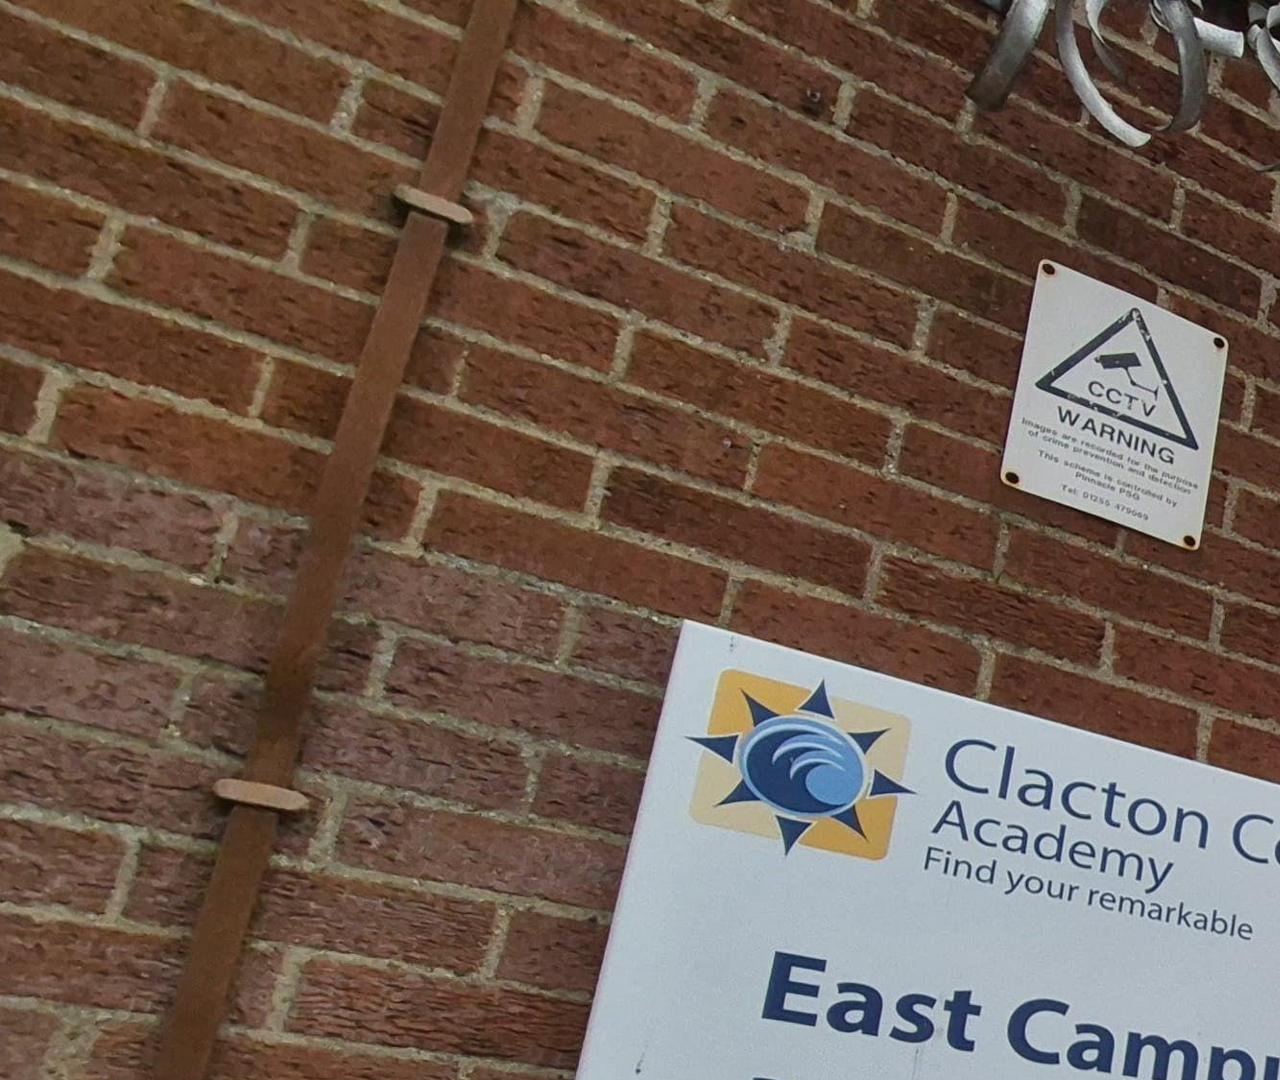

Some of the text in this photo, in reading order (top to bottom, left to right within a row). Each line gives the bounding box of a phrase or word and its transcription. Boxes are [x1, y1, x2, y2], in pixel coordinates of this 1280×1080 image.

[1088, 381, 1157, 417] CCTV
[1022, 417, 1058, 436] Images
[1062, 434, 1077, 443] are
[1081, 440, 1124, 460] recorded
[1144, 463, 1158, 473] the
[1162, 472, 1198, 490] purpose
[1028, 430, 1191, 494] of crime prevention and detection
[1057, 406, 1175, 465] WARNING
[1039, 449, 1177, 507] This scheme is controlled by
[1076, 471, 1115, 491] Pinnacle
[945, 739, 1209, 849] Clacton
[932, 800, 1174, 894] Academy
[924, 847, 1254, 940] Find your remarkable
[761, 951, 982, 1052] East
